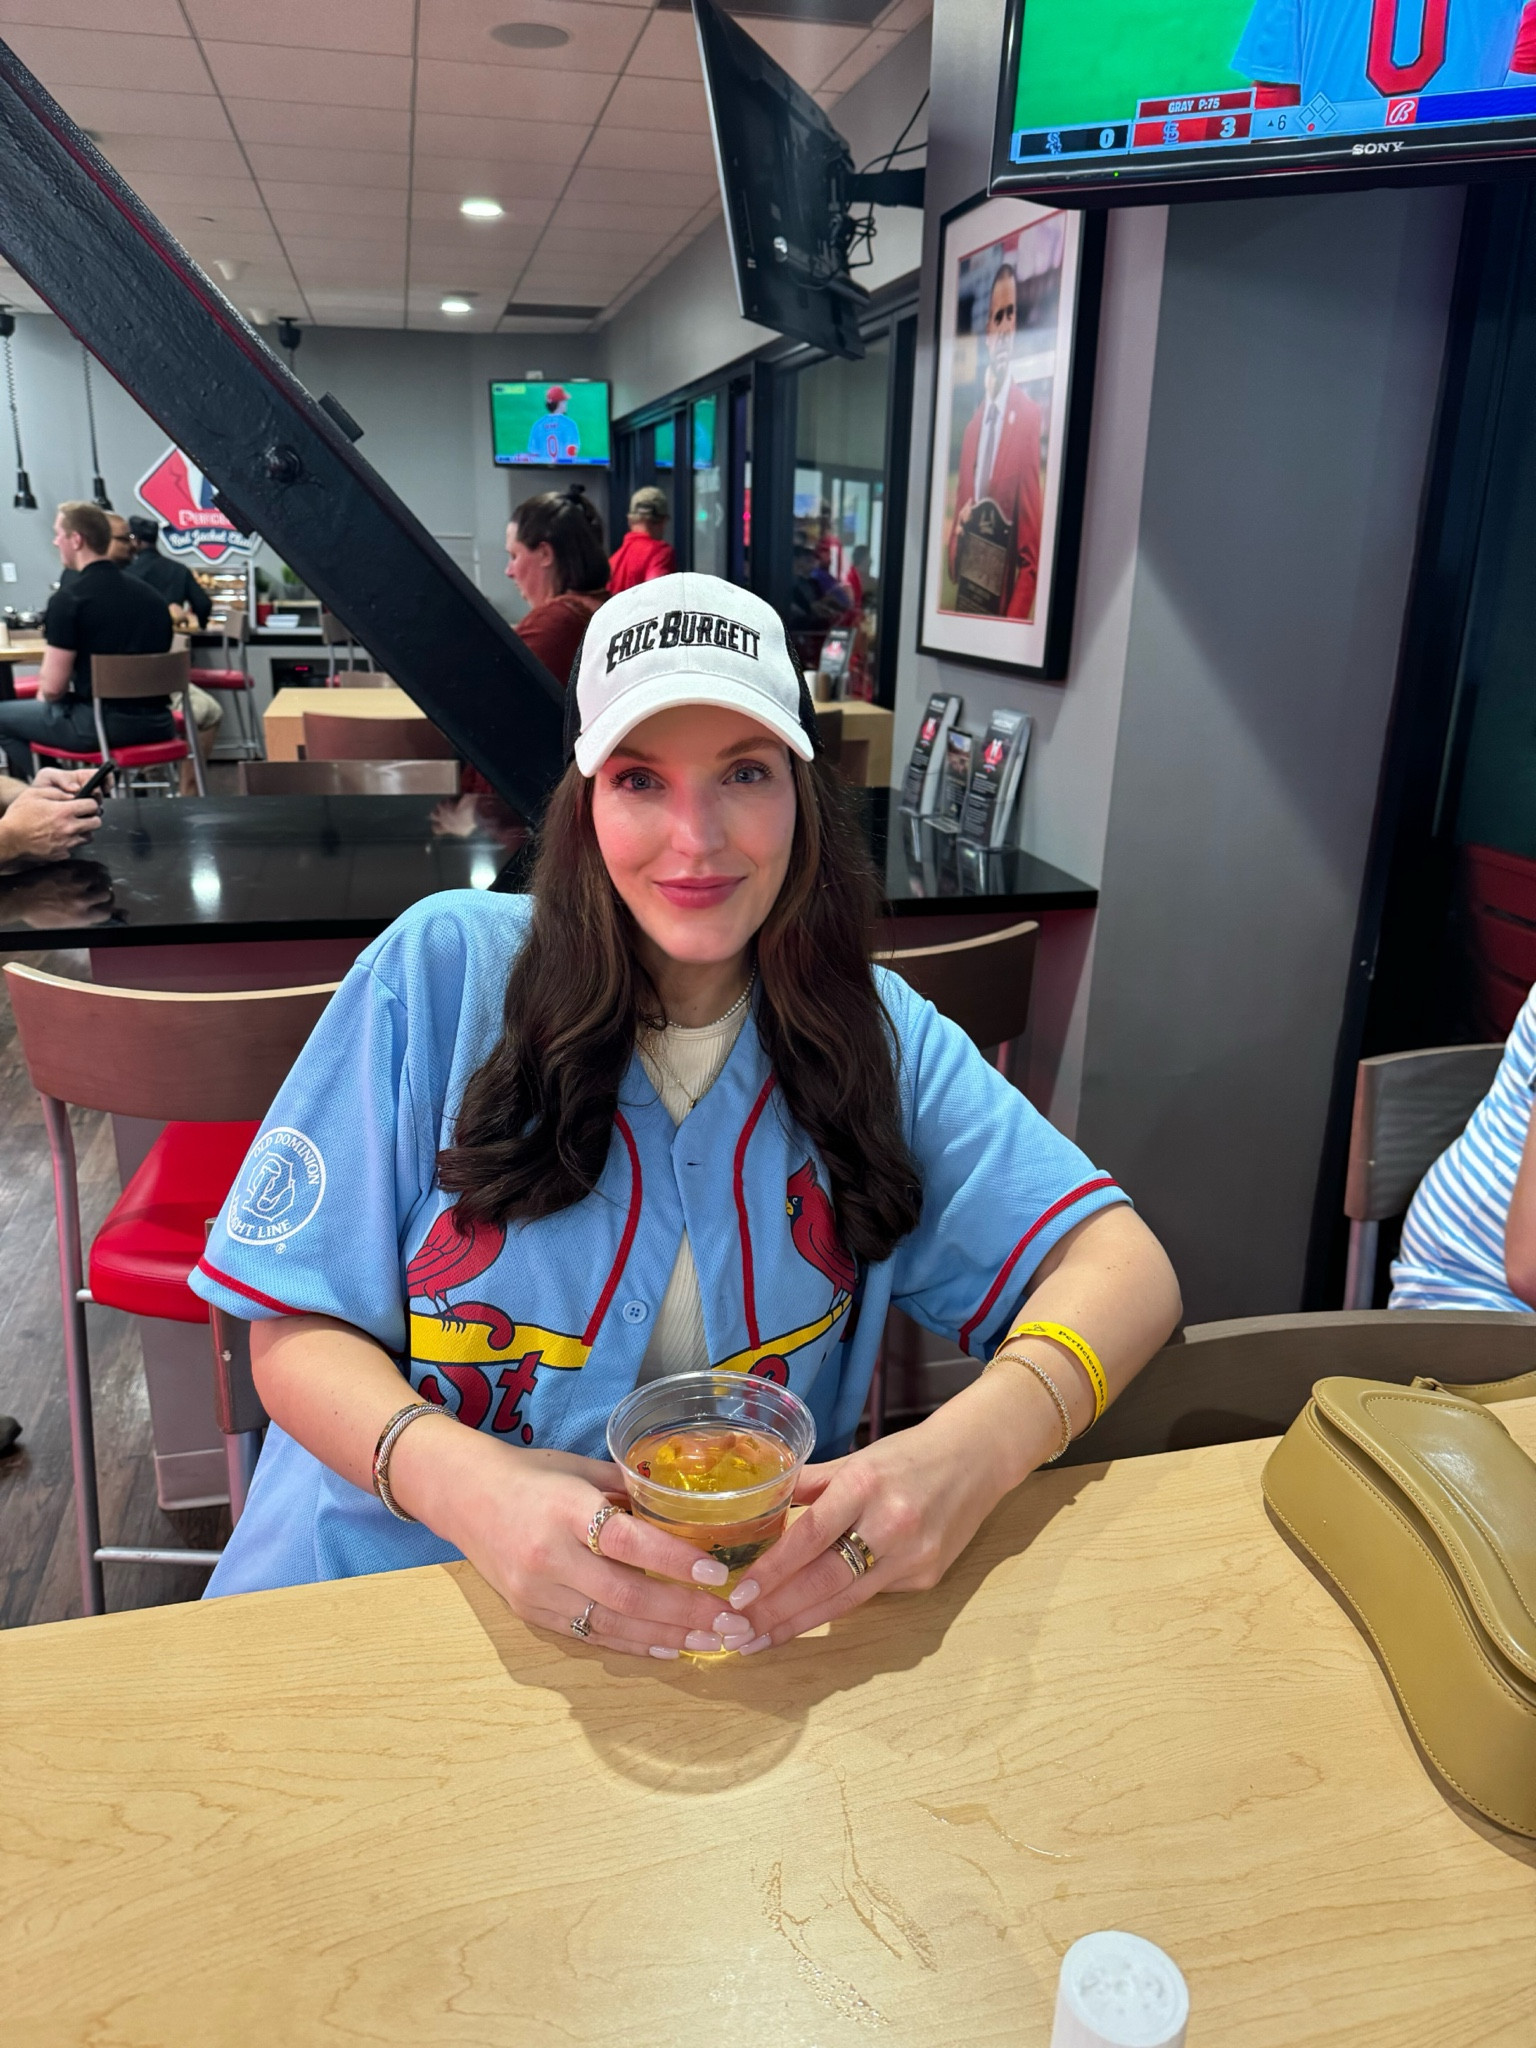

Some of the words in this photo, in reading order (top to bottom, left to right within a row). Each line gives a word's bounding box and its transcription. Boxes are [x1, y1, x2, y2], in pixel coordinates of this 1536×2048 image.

[1168, 99, 1194, 113] GRAY
[1198, 97, 1220, 110] P:75
[1099, 128, 1115, 149] 0
[1219, 117, 1236, 138] 3
[1277, 114, 1287, 131] 6
[1352, 141, 1404, 156] SONY
[606, 618, 658, 674] ERIC
[659, 610, 760, 661] BURGETT
[253, 1136, 273, 1158] OLD
[275, 1133, 319, 1185] DOMINION
[257, 1219, 292, 1238] LINE
[1058, 1330, 1099, 1377] Perficient
